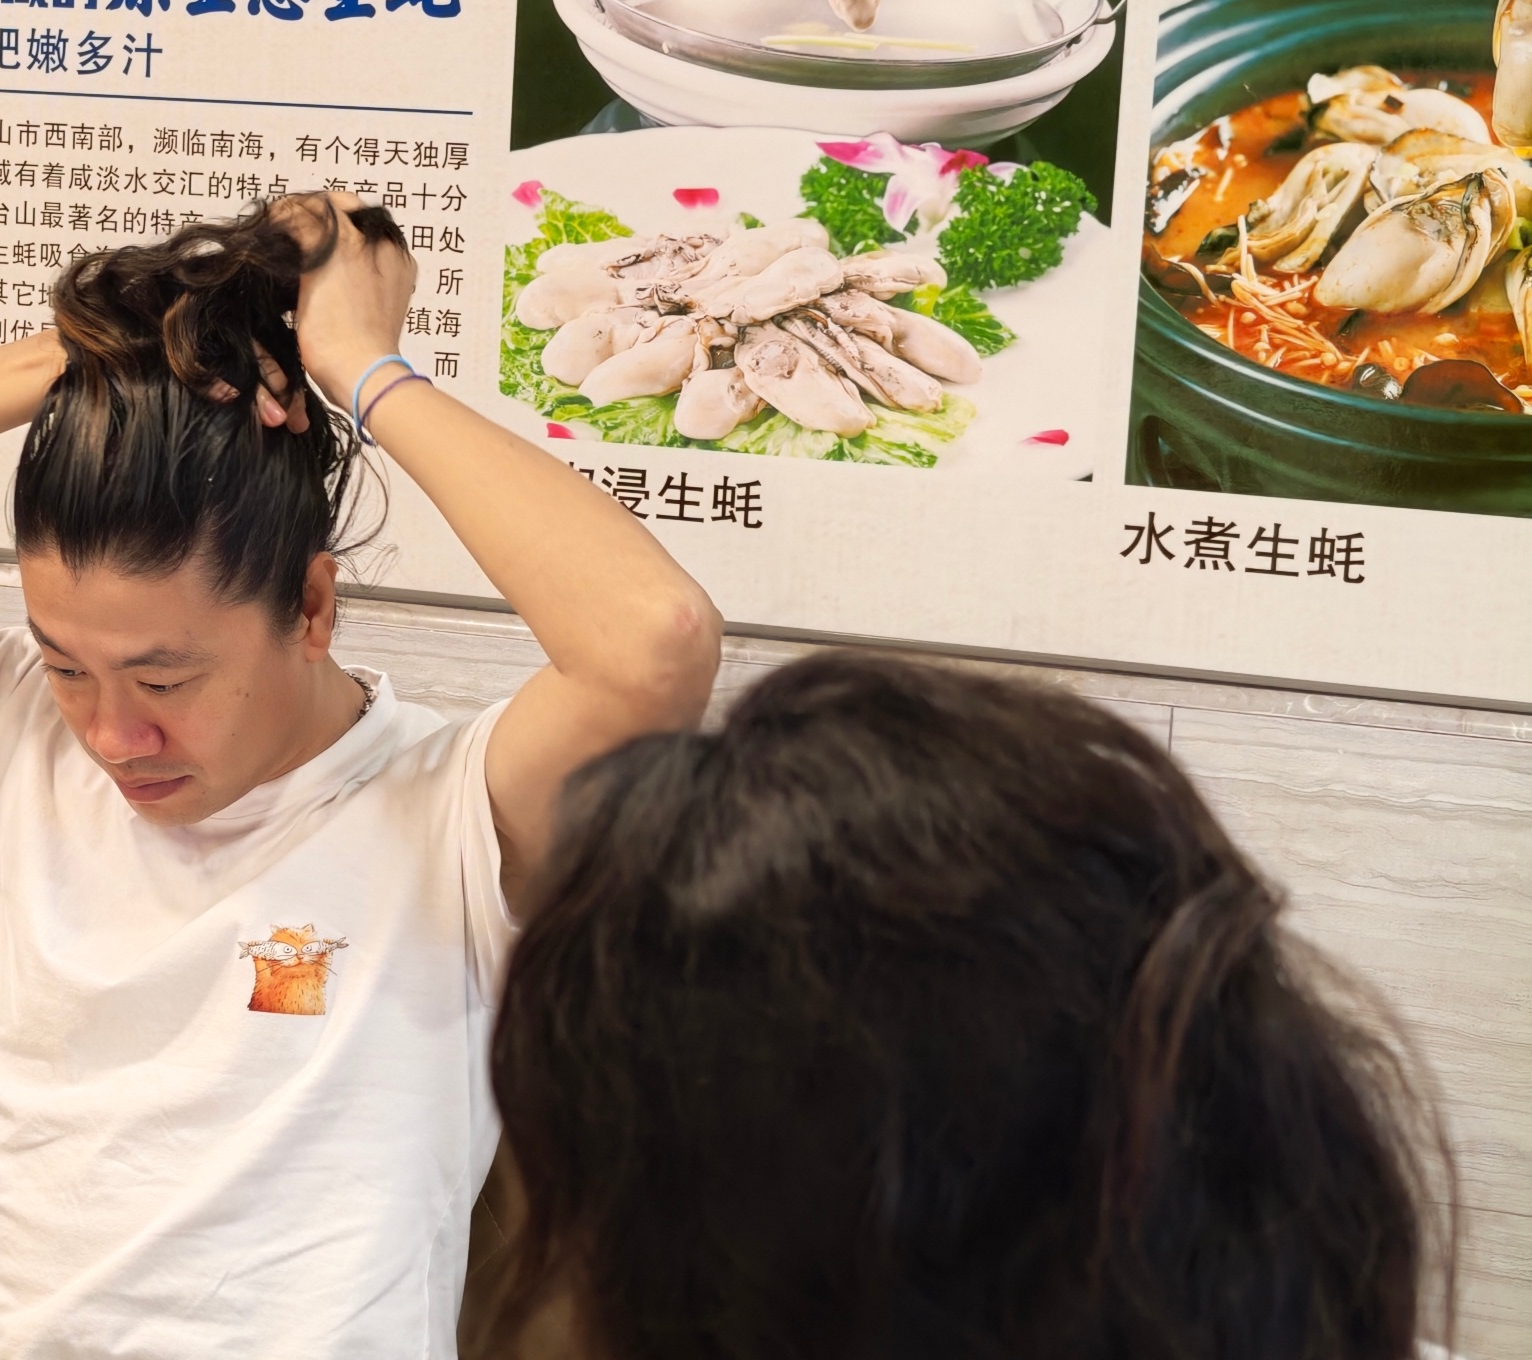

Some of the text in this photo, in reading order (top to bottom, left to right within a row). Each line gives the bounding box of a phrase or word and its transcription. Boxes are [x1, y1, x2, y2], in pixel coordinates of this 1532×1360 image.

[569, 461, 763, 529] 浸生蚝
[1120, 511, 1366, 584] 水煮生蚝
